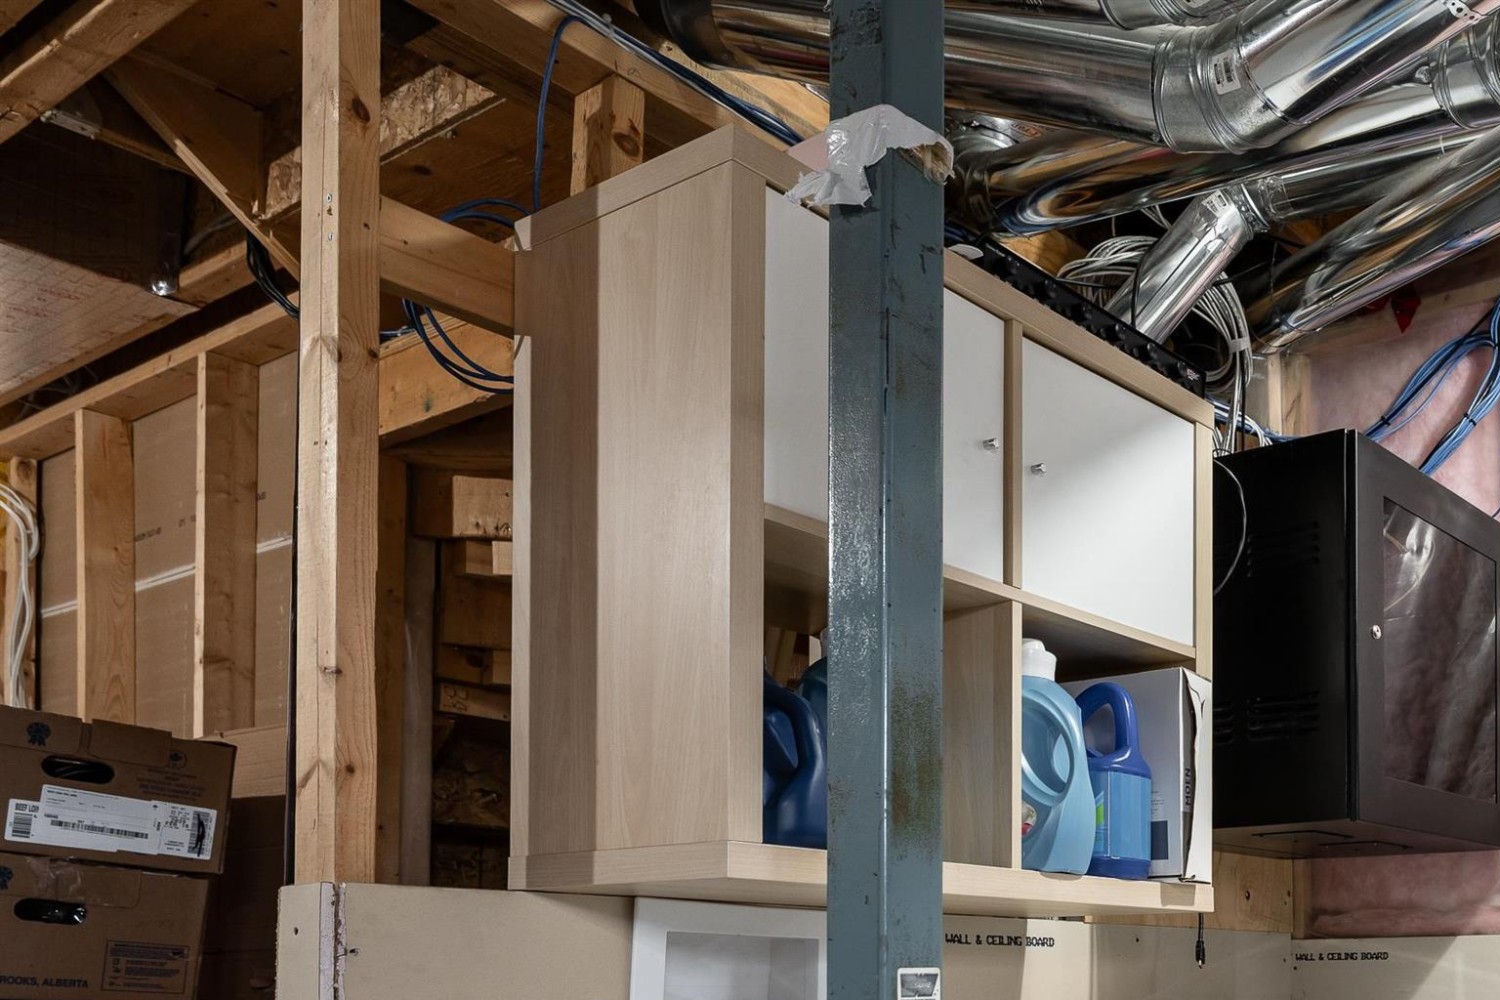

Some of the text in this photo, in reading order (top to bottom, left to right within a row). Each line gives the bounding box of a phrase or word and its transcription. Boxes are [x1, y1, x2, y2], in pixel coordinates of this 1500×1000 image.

[945, 933, 1055, 948] WALL & CEILING BOARD
[1295, 952, 1316, 961] WALL
[1327, 952, 1359, 961] CEILING
[1361, 951, 1389, 961] BOARD
[42, 977, 88, 989] ALBERTA
